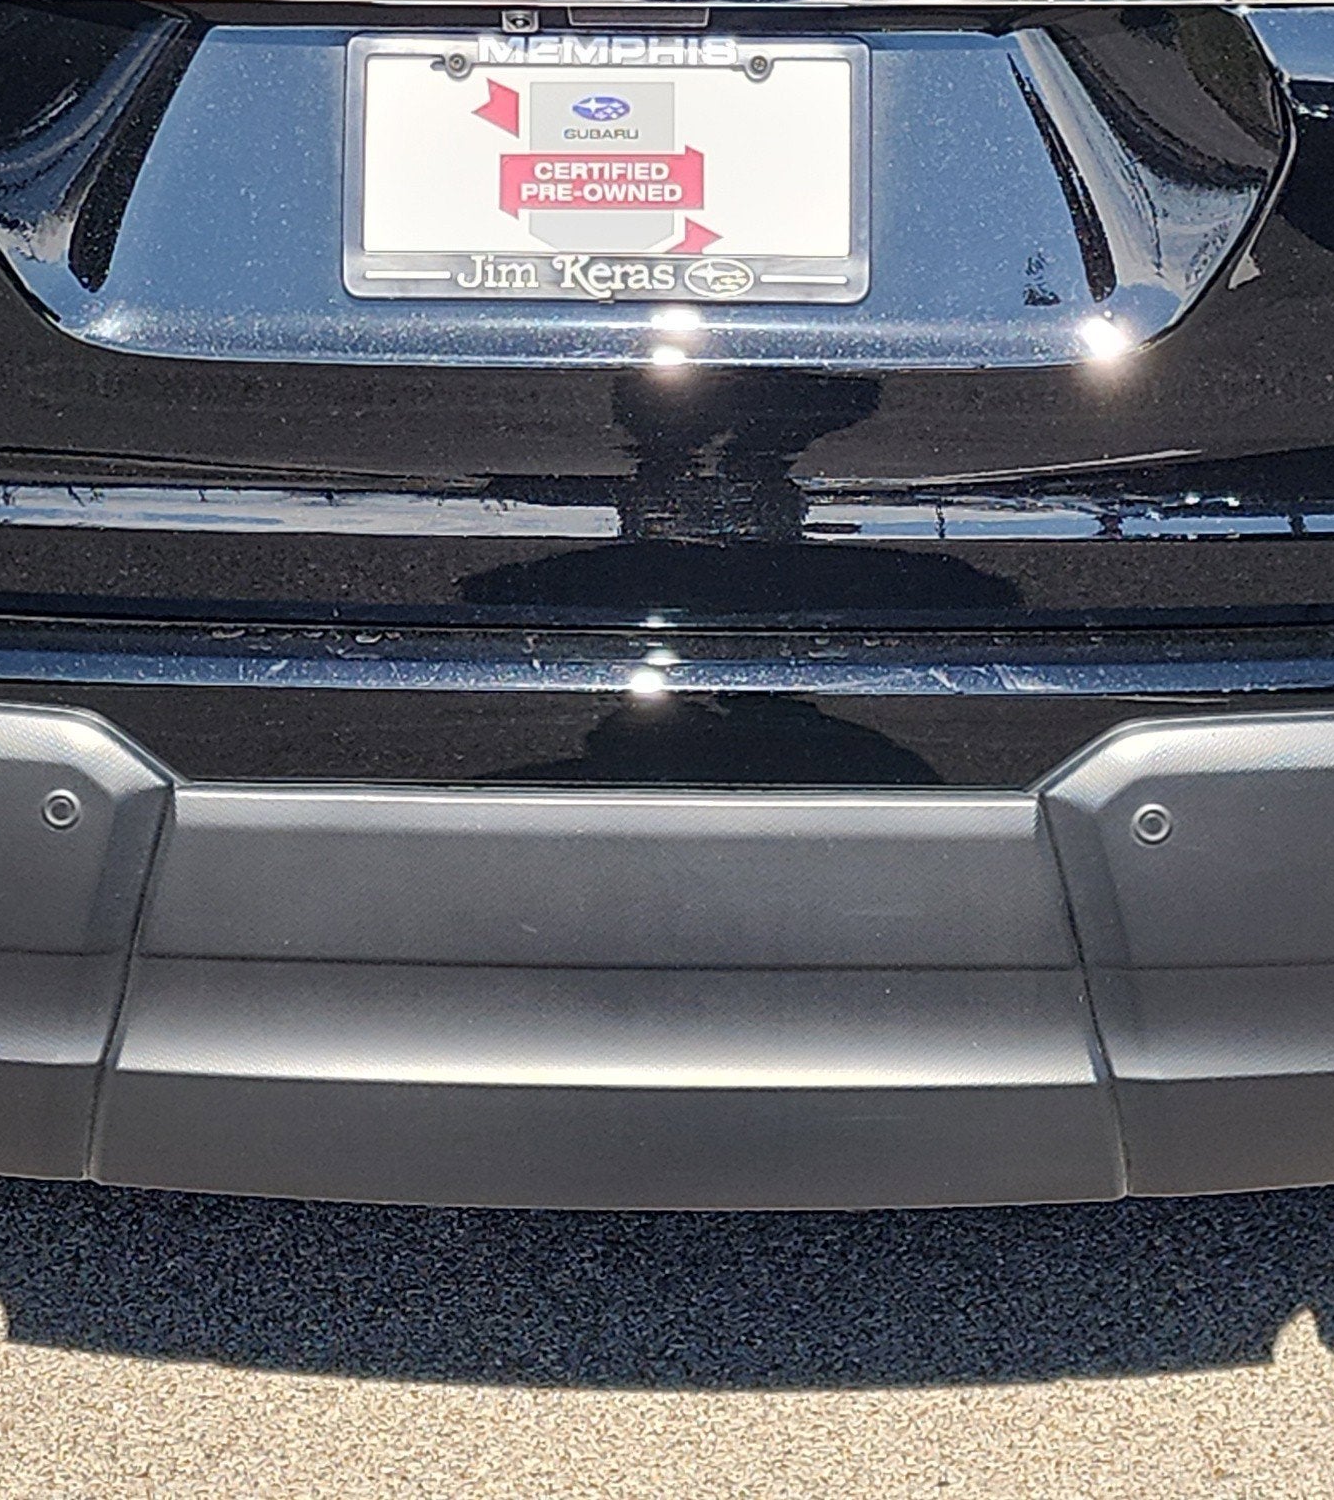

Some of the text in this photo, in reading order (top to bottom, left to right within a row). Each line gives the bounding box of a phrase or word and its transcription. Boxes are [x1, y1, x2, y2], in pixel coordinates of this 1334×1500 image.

[477, 36, 739, 66] MEMPHIS
[563, 127, 640, 140] SUBARU
[533, 162, 670, 181] CERTIFIED
[520, 183, 683, 202] PRE-OWNED
[457, 255, 675, 298] Jim Keras
